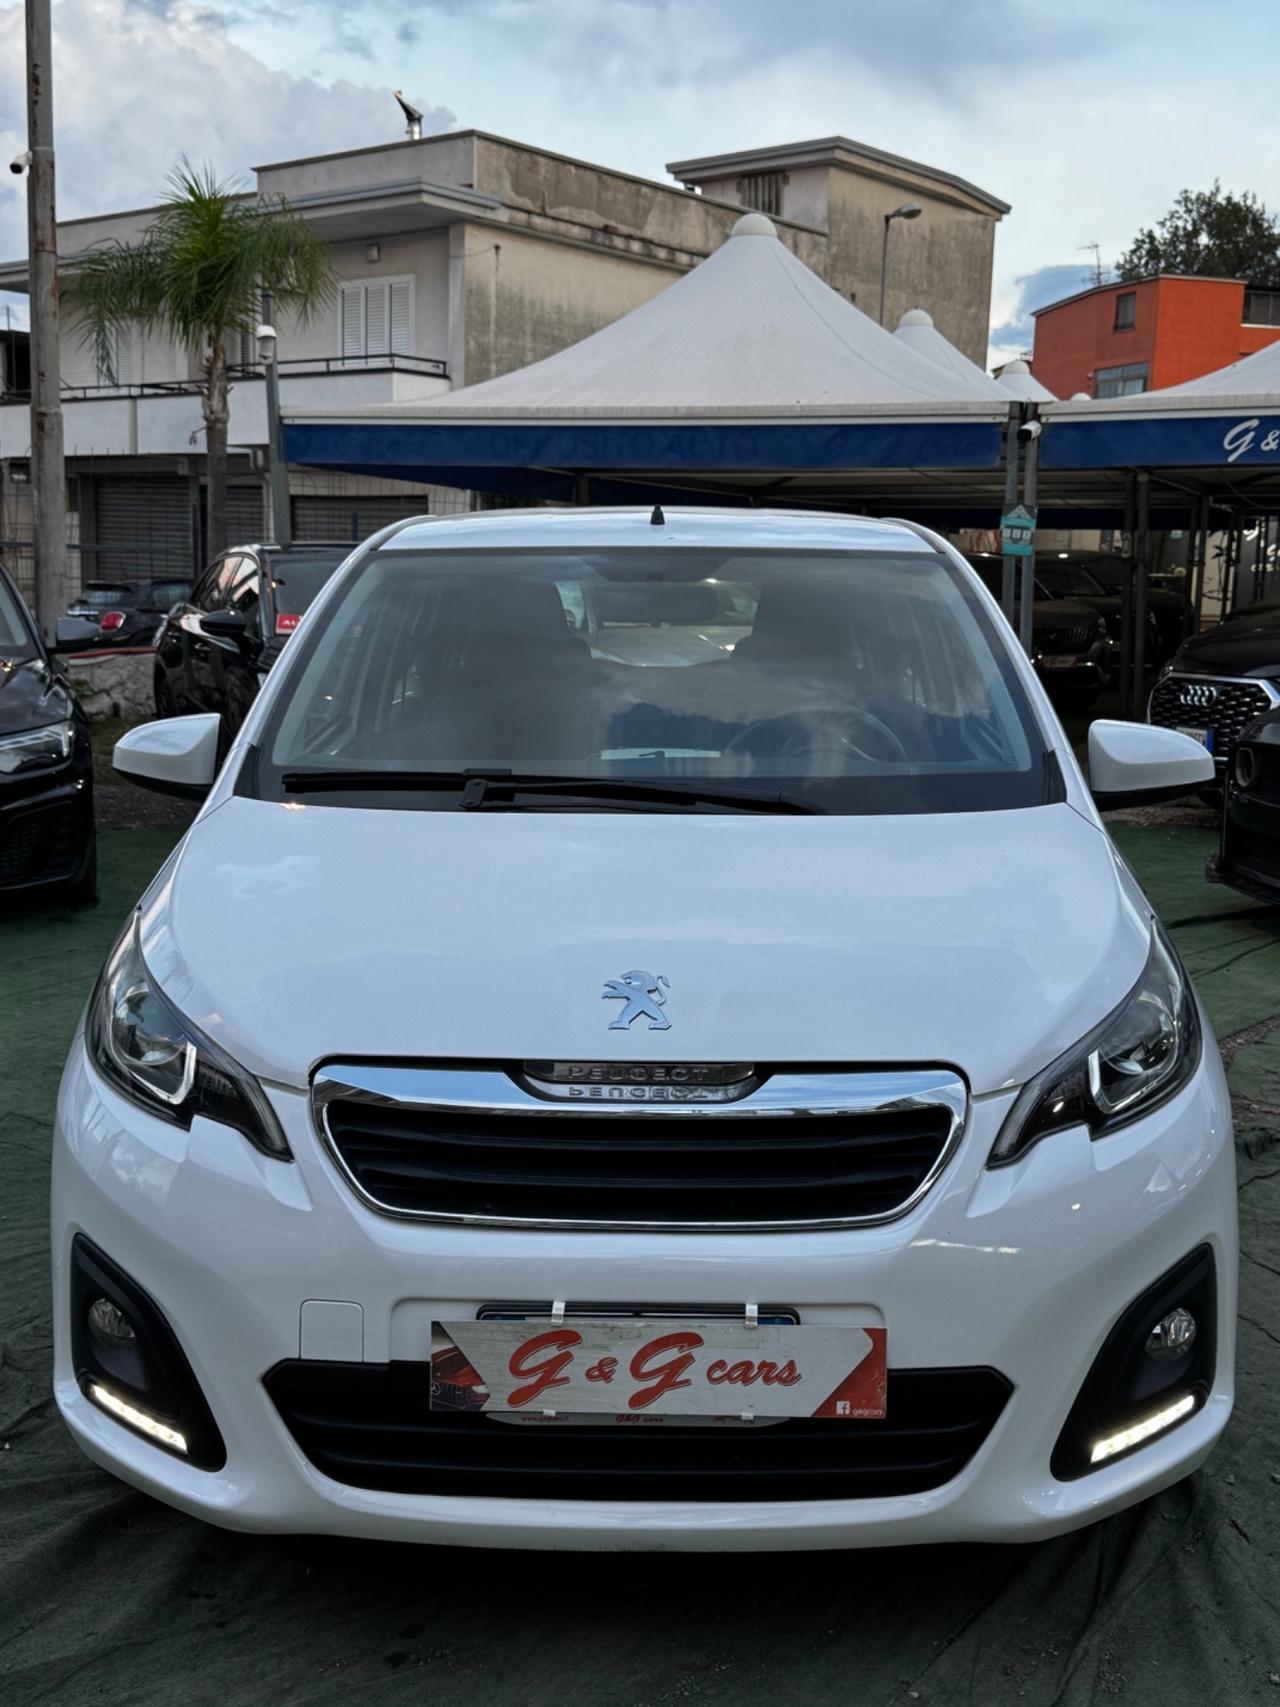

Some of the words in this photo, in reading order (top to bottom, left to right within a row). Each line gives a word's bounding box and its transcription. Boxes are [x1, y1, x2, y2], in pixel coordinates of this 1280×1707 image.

[1223, 418, 1260, 463] G
[568, 1066, 709, 1081] PEUGEOT
[507, 1329, 583, 1409] G
[585, 1357, 619, 1385] &
[628, 1331, 704, 1410] G
[706, 1358, 802, 1387] cars
